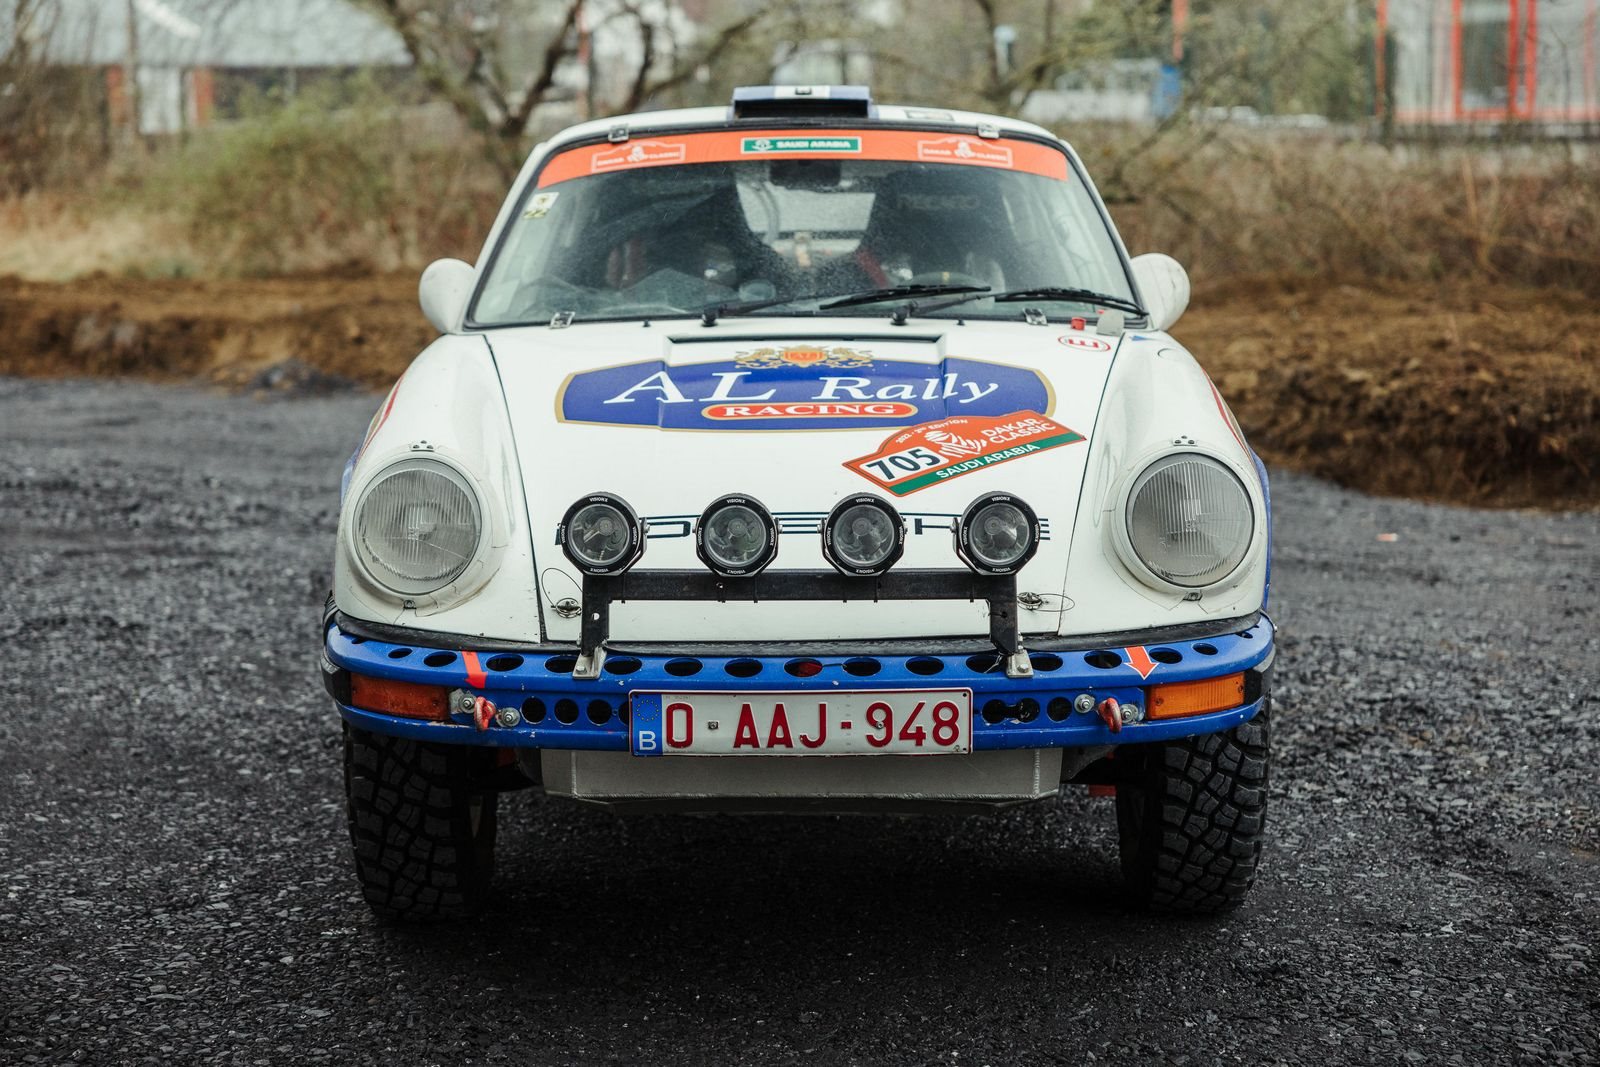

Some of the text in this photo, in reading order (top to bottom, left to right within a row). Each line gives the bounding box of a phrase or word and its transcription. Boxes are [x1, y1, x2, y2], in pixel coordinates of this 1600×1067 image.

[776, 141, 851, 149] SAUDI ARABIA
[603, 371, 999, 404] AL Rally
[723, 404, 896, 418] RACING
[981, 418, 1039, 437] DAKAR
[989, 423, 1056, 443] CLASSIC
[866, 448, 941, 480] 705
[936, 443, 1041, 478] SAUDI ARABIA
[639, 730, 657, 751] B
